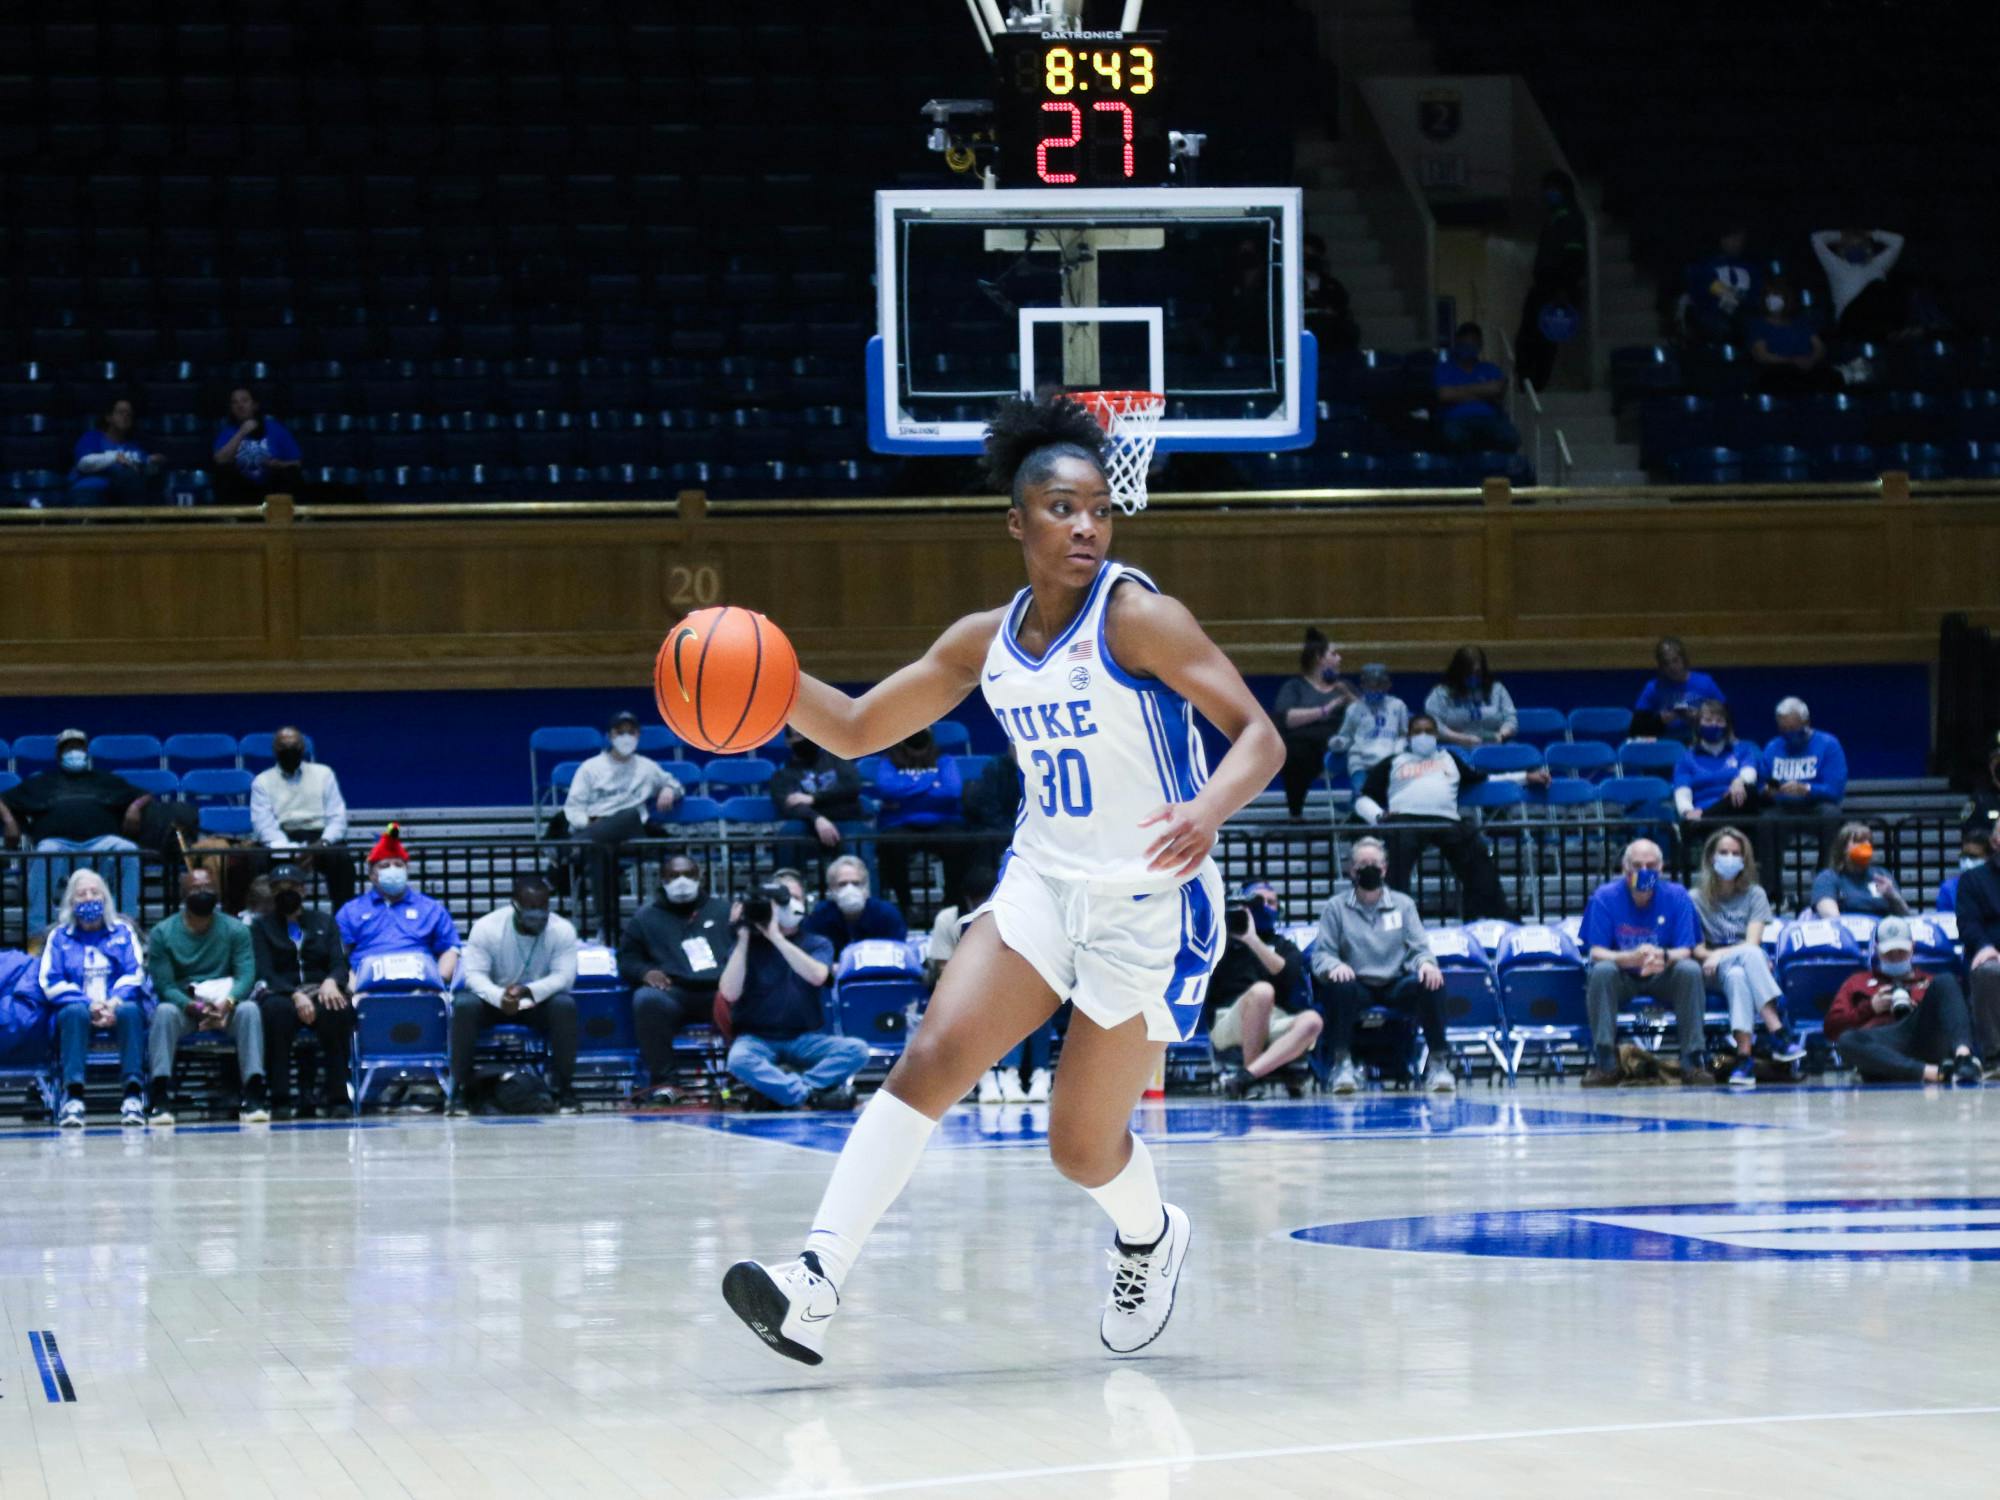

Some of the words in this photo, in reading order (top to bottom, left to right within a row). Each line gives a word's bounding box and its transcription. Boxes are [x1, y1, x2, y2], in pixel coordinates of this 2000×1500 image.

[1041, 31, 1123, 40] DAKTRONICS
[1046, 48, 1154, 95] 8:43
[1037, 102, 1134, 183] 27
[669, 566, 721, 604] 20
[1031, 748, 1093, 817] 30
[1773, 756, 1818, 780] DUKE
